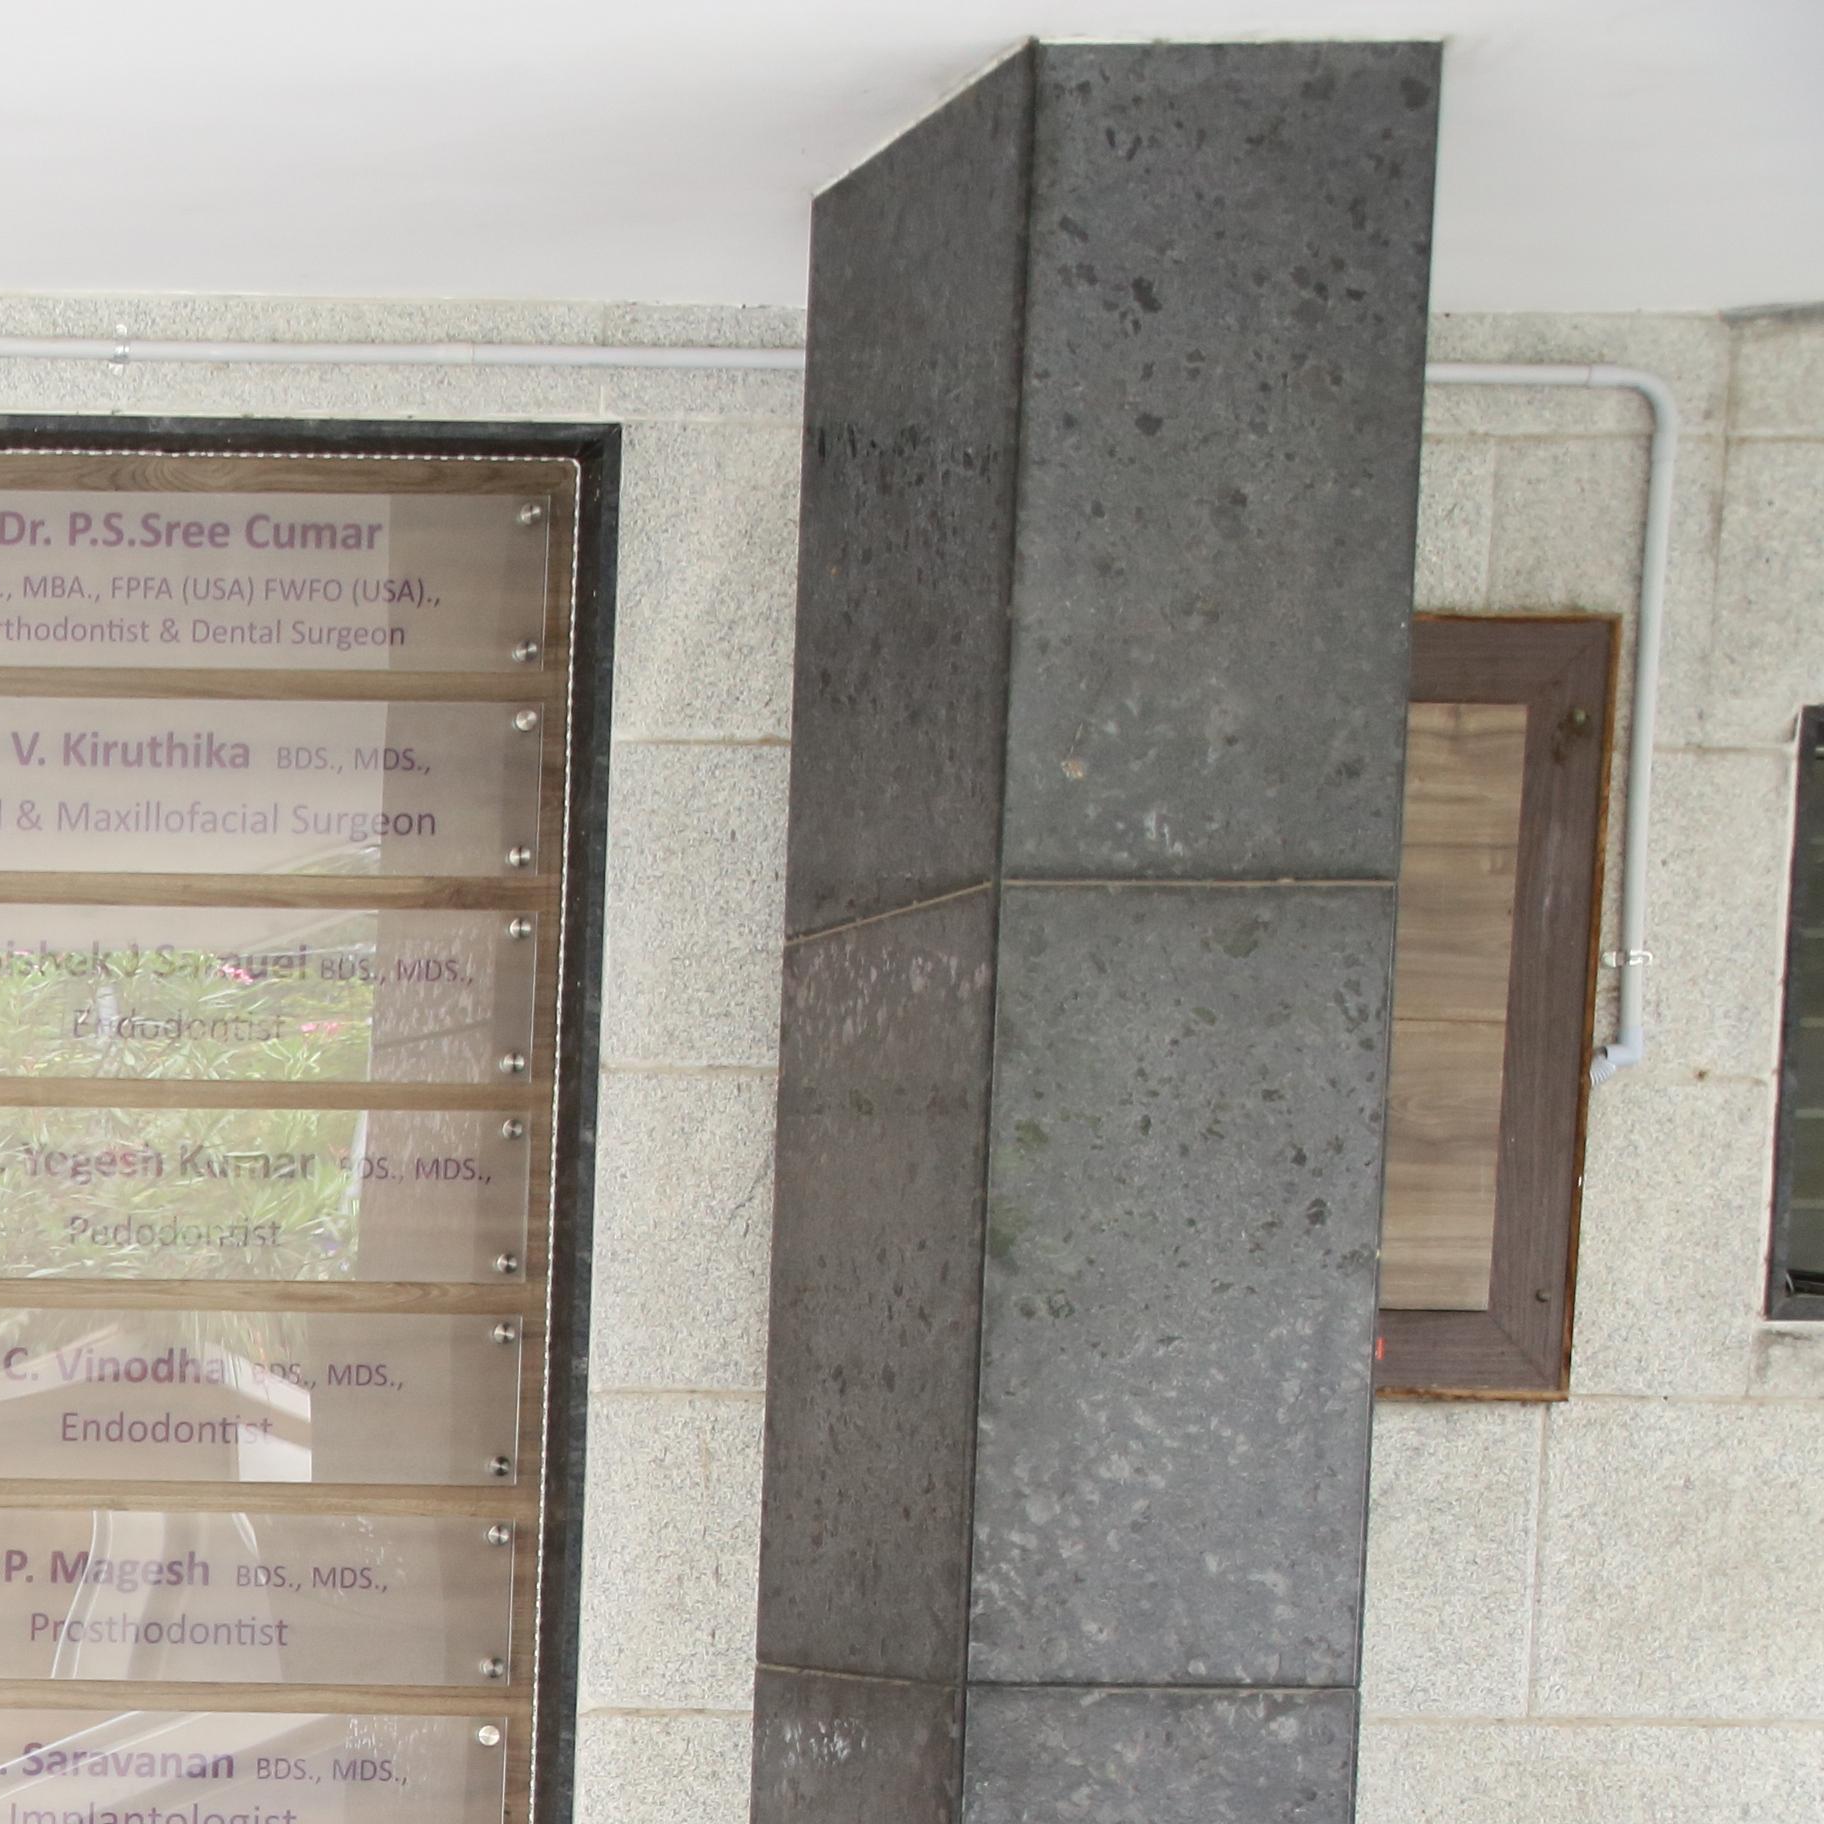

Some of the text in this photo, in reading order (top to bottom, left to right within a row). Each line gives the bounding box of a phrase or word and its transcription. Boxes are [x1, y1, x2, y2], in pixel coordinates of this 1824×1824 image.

[68, 511, 230, 548] P.S.Sree
[245, 514, 382, 549] Cumar
[22, 575, 100, 602] MBA.,
[111, 576, 173, 600] FPFA
[182, 576, 253, 605] (USA)
[264, 577, 342, 601] FWFO
[353, 578, 440, 607] (USA).,
[160, 619, 180, 644] &
[192, 619, 280, 645] Dental
[291, 621, 405, 651] Surgeon
[11, 732, 45, 766] V.
[63, 732, 250, 769] Kiruthika
[277, 747, 343, 774] BDS.,
[354, 747, 431, 775] MDS.,
[16, 801, 42, 831] &
[57, 801, 277, 834] Maxillofacial
[291, 805, 436, 843] Surgeon
[397, 959, 474, 986] MDS.,
[72, 1006, 284, 1043] Endodontist
[23, 1142, 164, 1185] Yogesh
[180, 1143, 315, 1179] Kumar
[415, 1158, 492, 1185] MDS.,
[70, 1214, 282, 1248] Pedodontist
[4, 1347, 39, 1381] C.
[327, 1363, 404, 1390] MDS.,
[62, 1412, 273, 1444] Endodontist
[3, 1549, 33, 1583] P.
[51, 1551, 210, 1591] Magesh
[236, 1566, 301, 1591] BDS.,
[312, 1566, 387, 1593] MDS.,
[31, 1612, 288, 1647] Prosthodontist
[22, 1743, 234, 1779] Saravanan
[257, 1758, 320, 1784] BDS.,
[332, 1759, 408, 1786] MDS.,
